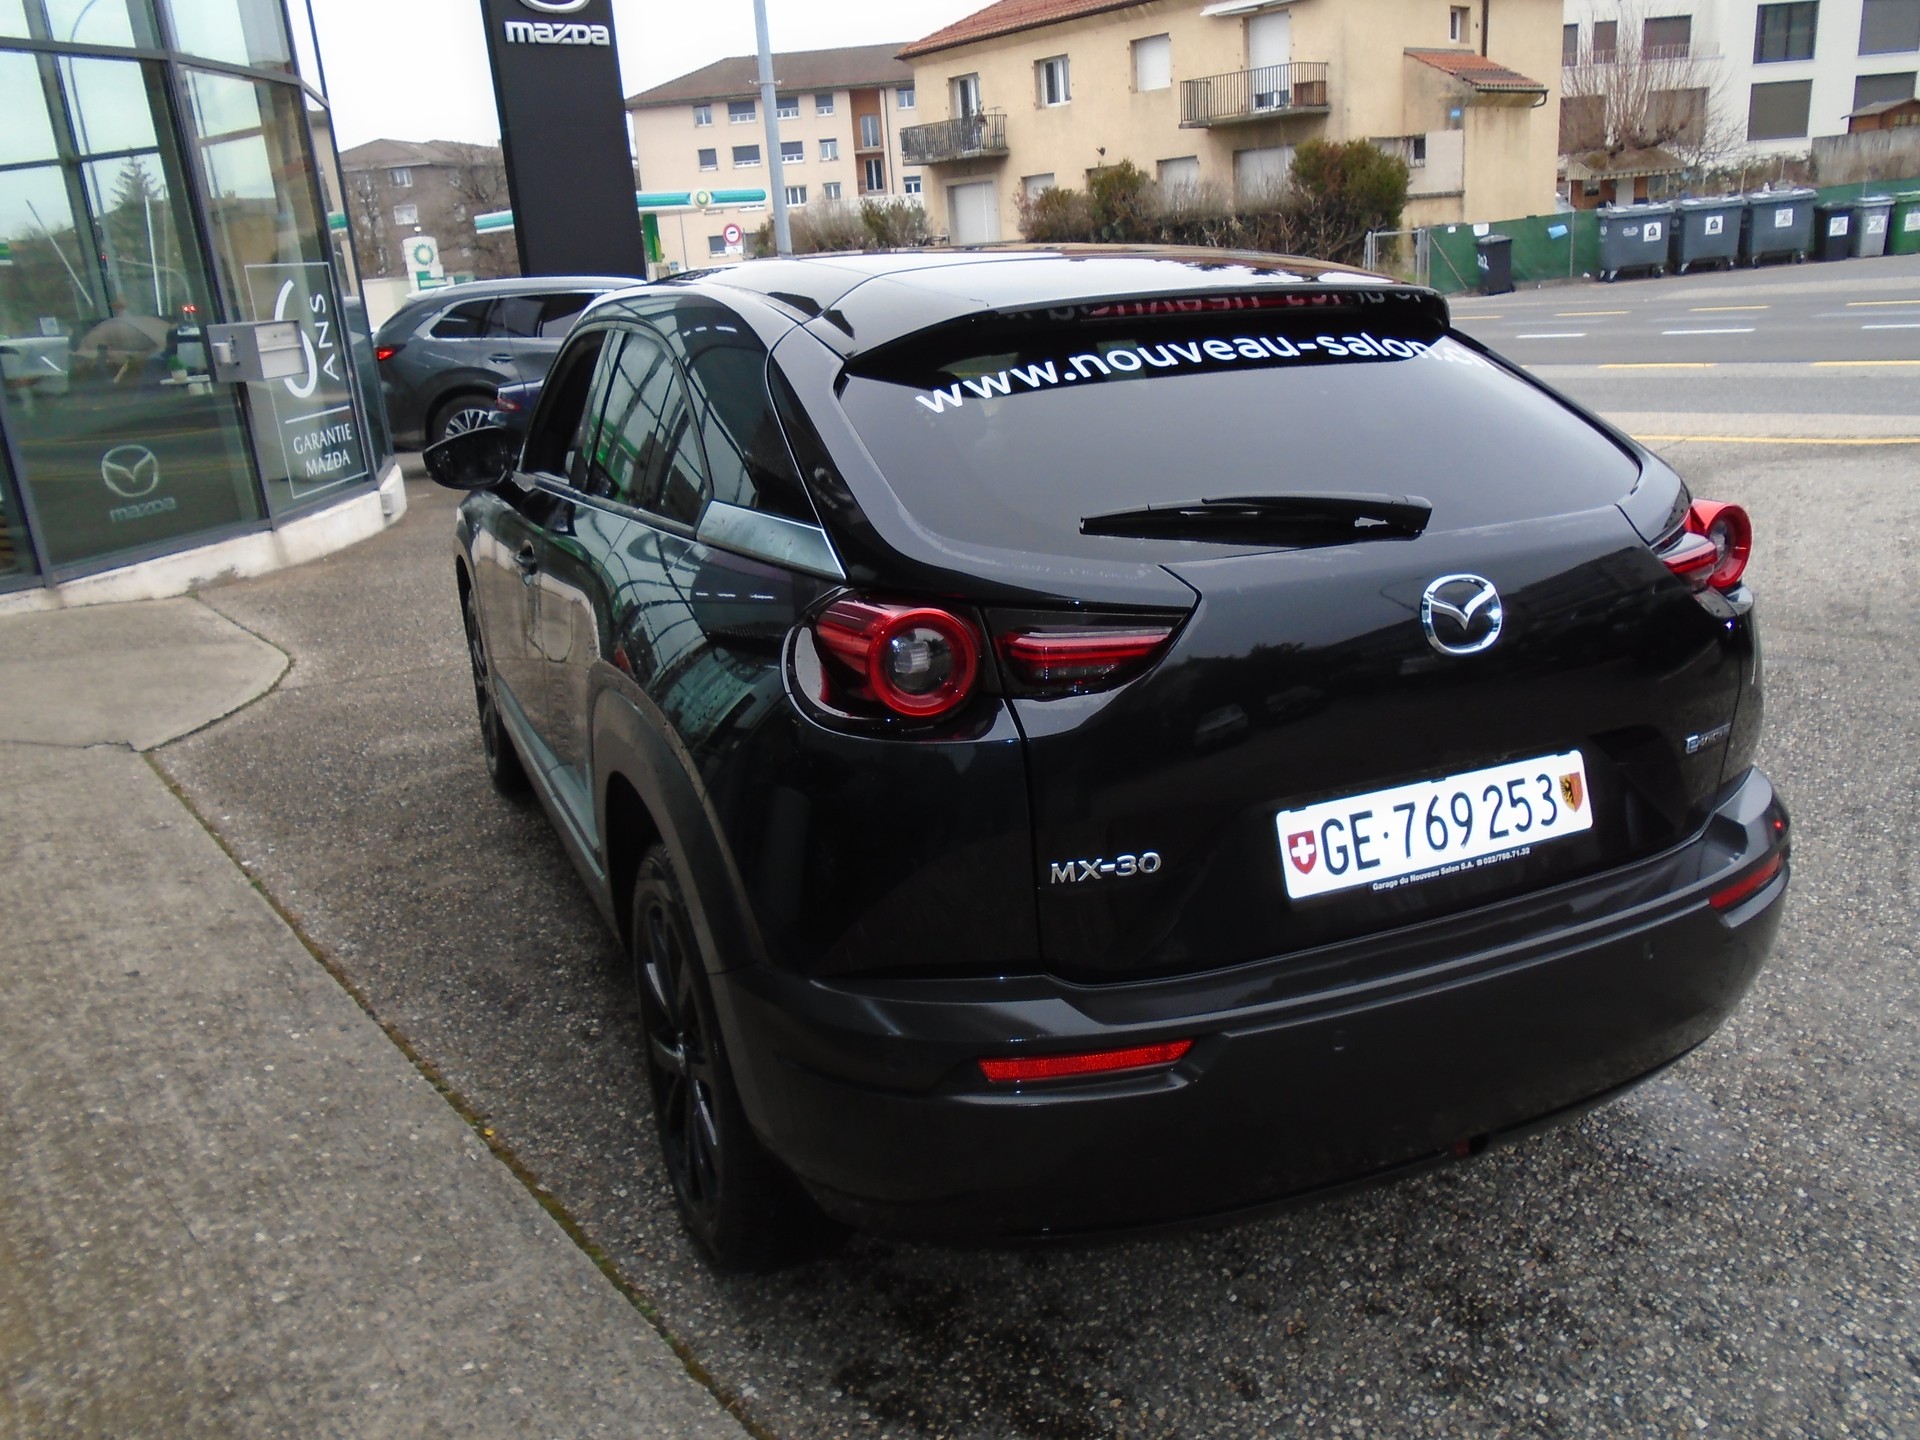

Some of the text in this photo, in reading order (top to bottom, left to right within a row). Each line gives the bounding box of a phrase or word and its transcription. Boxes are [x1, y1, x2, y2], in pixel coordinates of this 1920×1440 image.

[504, 21, 610, 46] mazda
[311, 293, 341, 381] ANS
[293, 422, 353, 455] GARANTIE
[305, 449, 351, 478] MAZDA
[109, 497, 176, 522] mazda
[1051, 852, 1161, 884] MX-30
[1400, 876, 1409, 884] du
[1410, 870, 1440, 882] Nouveau
[1441, 865, 1459, 875] Salon
